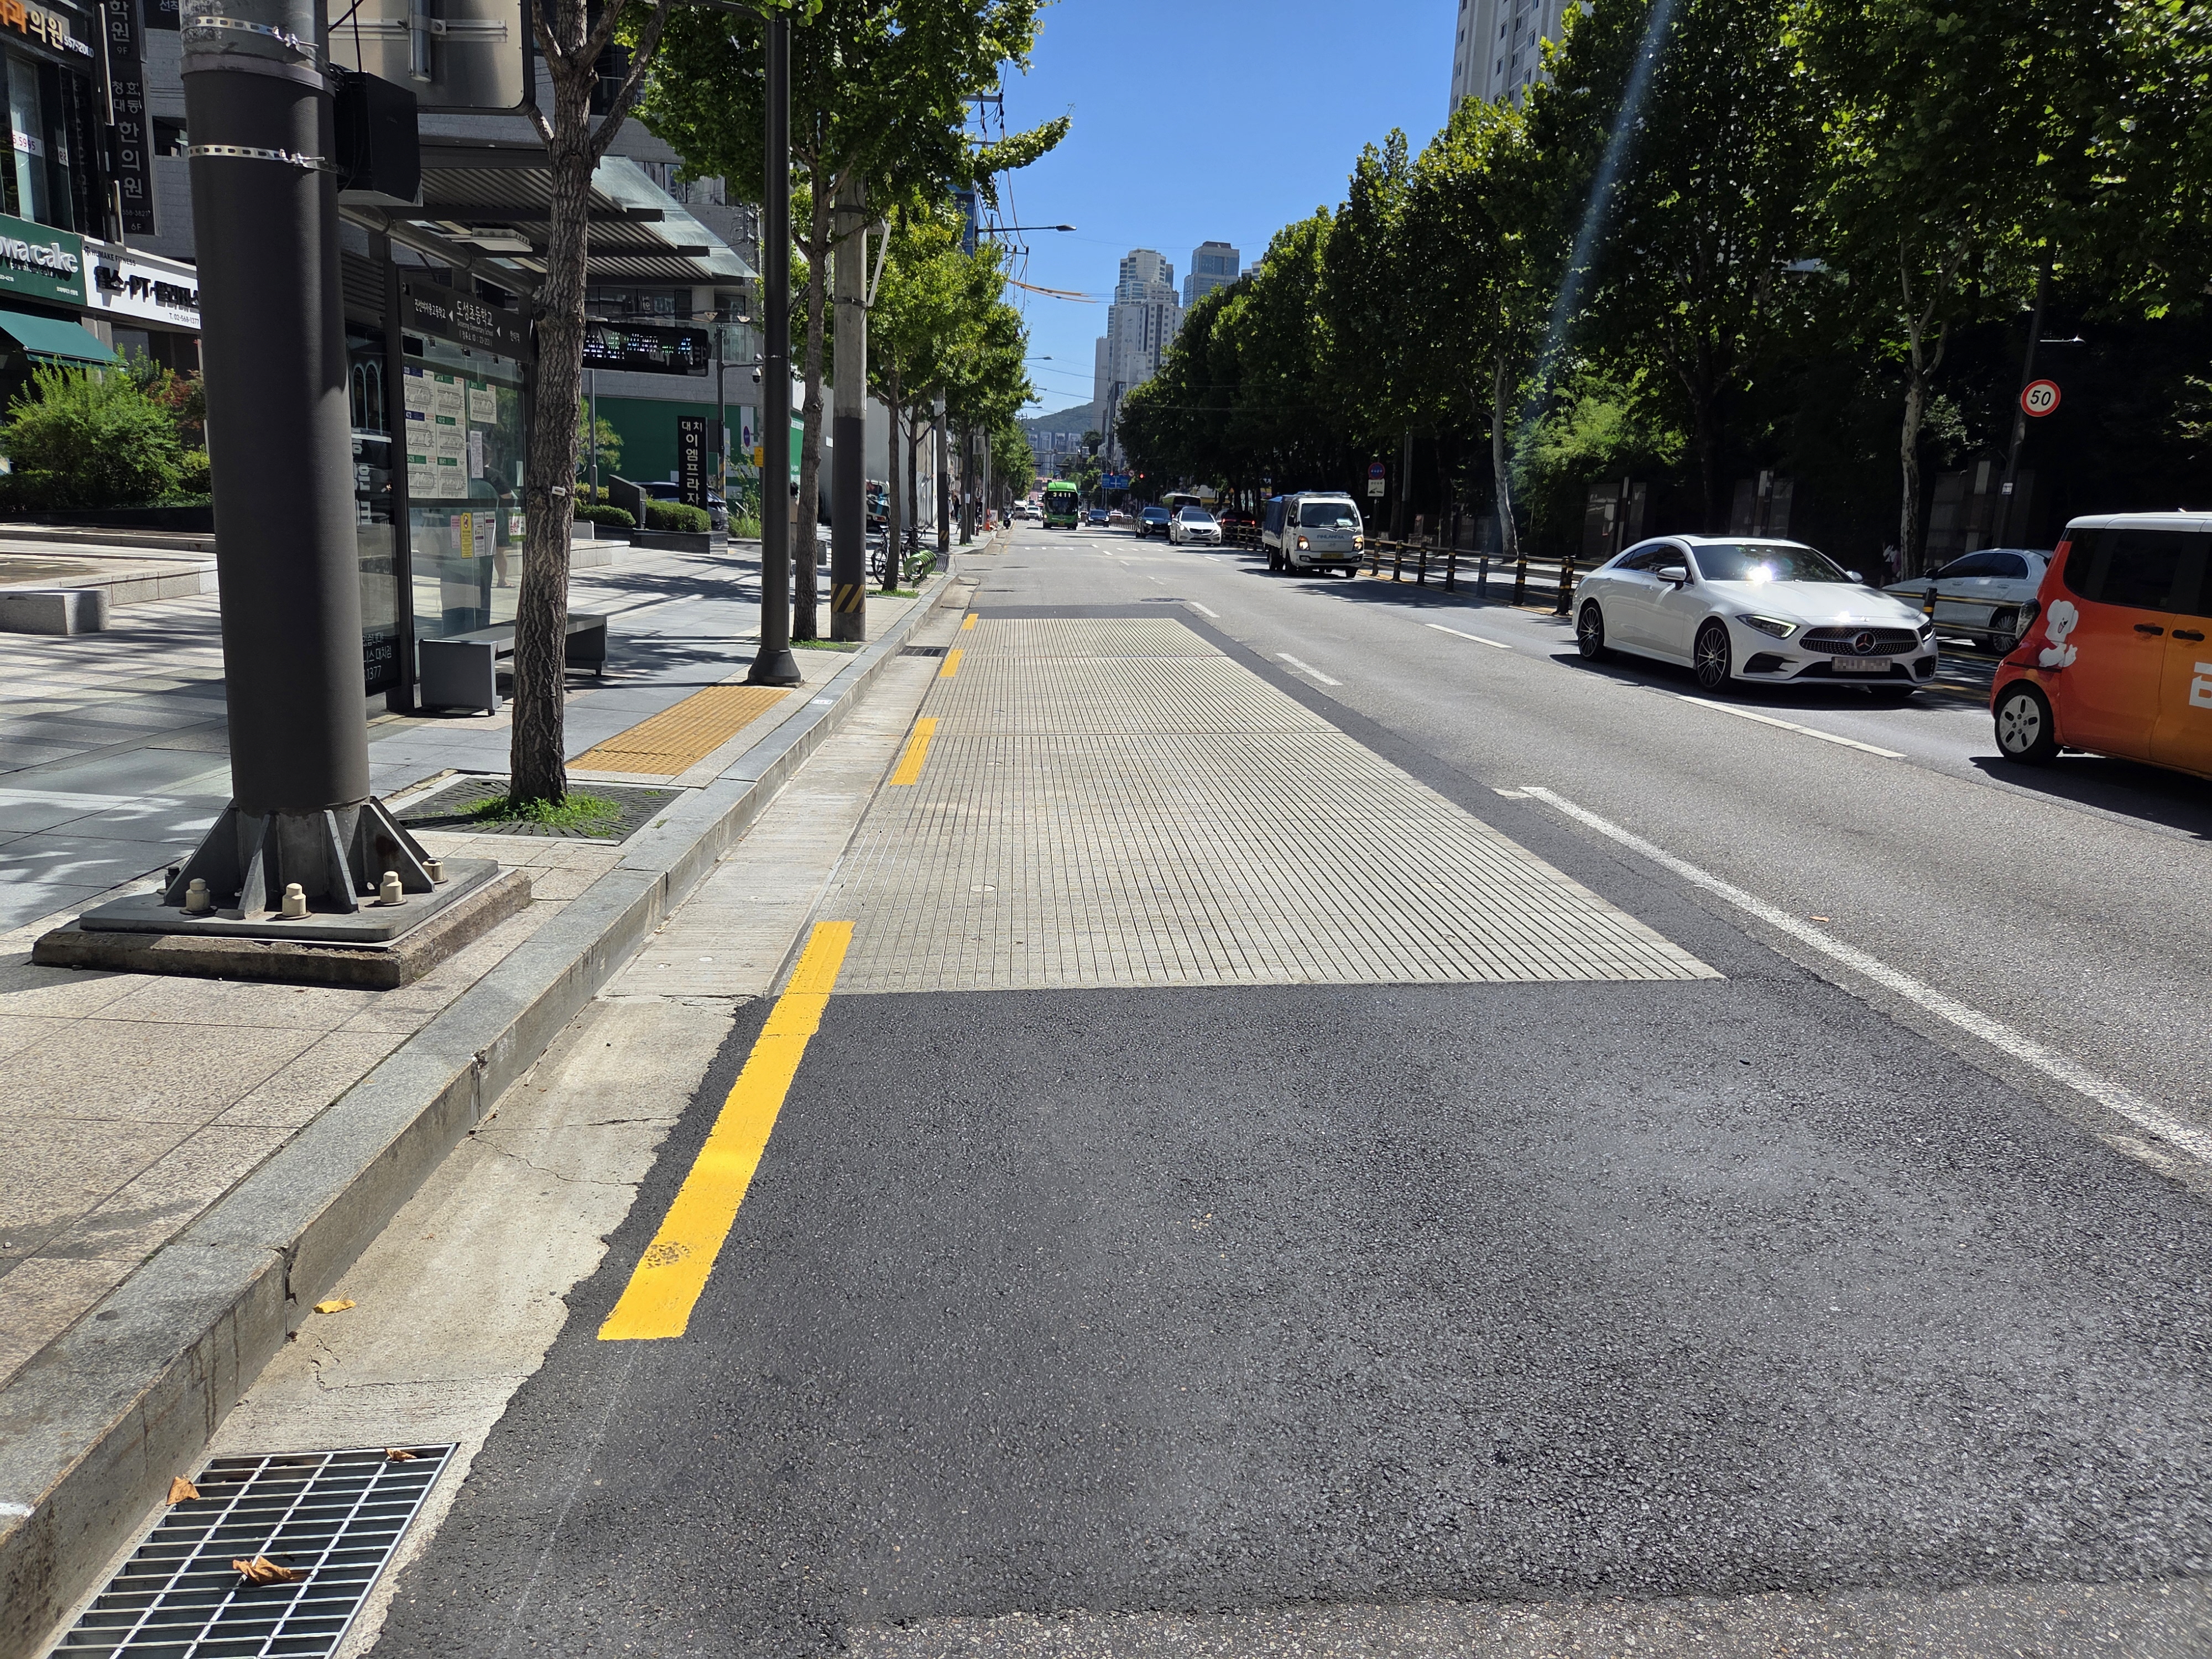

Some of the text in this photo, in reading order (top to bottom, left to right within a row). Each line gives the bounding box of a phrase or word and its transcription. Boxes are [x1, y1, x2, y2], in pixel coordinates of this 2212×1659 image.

[117, 46, 128, 55] 9F
[113, 99, 139, 114] 대동
[118, 121, 143, 199] 한의원
[131, 223, 142, 231] 6F
[91, 249, 136, 267] HUMAKE FITNESS
[456, 300, 493, 326] 도성초등학교
[2030, 390, 2051, 406] 50
[681, 421, 702, 432] 대치
[685, 434, 701, 505] 이엠프라자
[375, 644, 392, 660] 대치점
[363, 665, 382, 681] .1377
